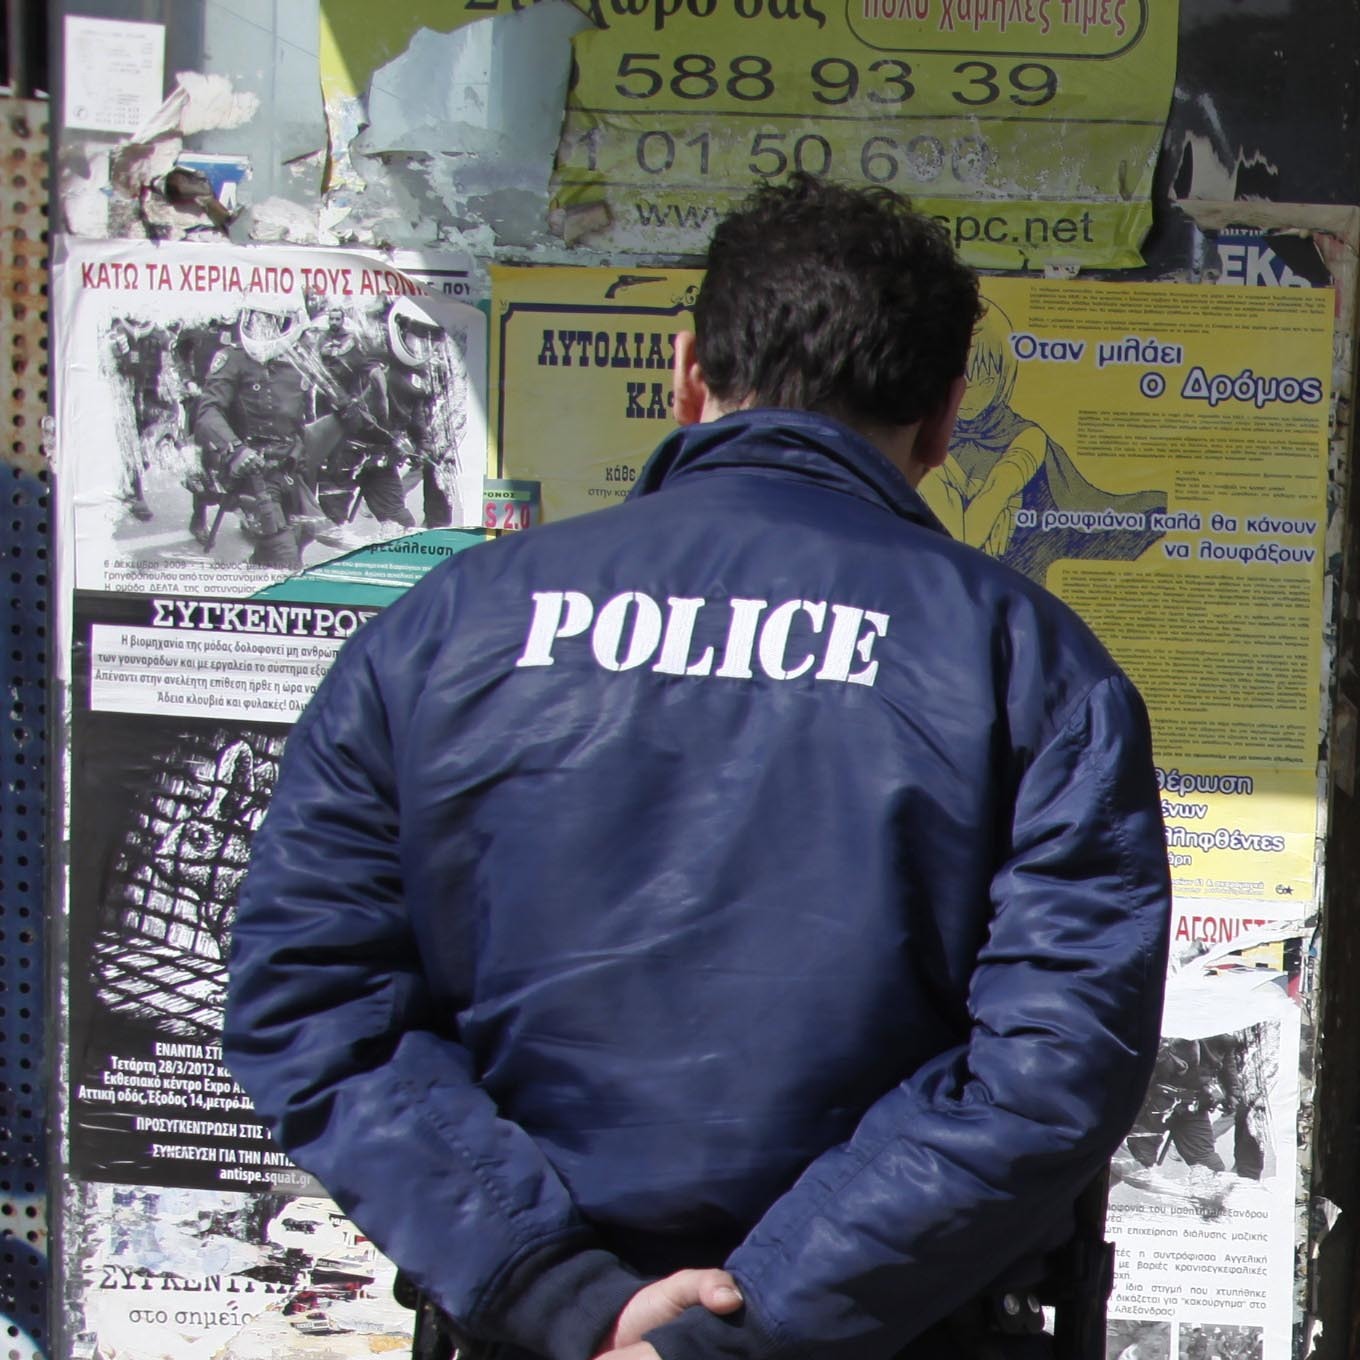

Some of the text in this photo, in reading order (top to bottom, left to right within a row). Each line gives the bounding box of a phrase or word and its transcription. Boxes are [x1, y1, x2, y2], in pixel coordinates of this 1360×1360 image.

[614, 52, 1059, 107] 588 93 39
[635, 130, 833, 178] 01 50
[81, 261, 354, 296] ΚΑΤΩ ΤΑ ΧΕΡΙΑ ΑΠΟ ΤΟΥΣ
[1009, 332, 1183, 367] Όταν μιλάει
[1139, 366, 1323, 409] ο Δρόμος
[605, 464, 637, 482] κάθε
[587, 487, 613, 499] στην
[503, 502, 531, 530] 2.0
[1016, 510, 1317, 534] οι ρουφιάνοι καλά θα κάνουν
[1164, 540, 1316, 563] να λουφάξουν
[130, 633, 299, 658] βιομηχανία της μόδας δολοφονεί μη
[515, 590, 892, 688] POLICE
[98, 653, 309, 677] των γουναράδων και με το σύστημα
[95, 669, 303, 695] Απέναντι στην ανελέητη επίθεση ήρθε ώρα
[157, 691, 287, 713] Άδεια κλουβιά και φυλακές!
[155, 1041, 204, 1060] ΕΝΑΝΤΙΑ
[110, 1055, 215, 1077] Τετάρτη 28/3/2012
[78, 1085, 116, 1104] Αττική
[103, 1071, 231, 1097] Εκθεσιακό κέντρο Expo
[136, 1116, 264, 1140] ΠΡΟΣΥΓΚΕΝΤΡΩΣΗ ΣΤΙΣ
[152, 1143, 262, 1164] ΣΥΝΕΛΕΥΣΗ ΓΙΑ ΤΗΝ
[219, 1166, 312, 1186] antispe.squat.gr
[1127, 1226, 1227, 1240] επιχείρηση διάλυσης
[1224, 1252, 1268, 1264] Αγγελική
[128, 1309, 168, 1325] στο
